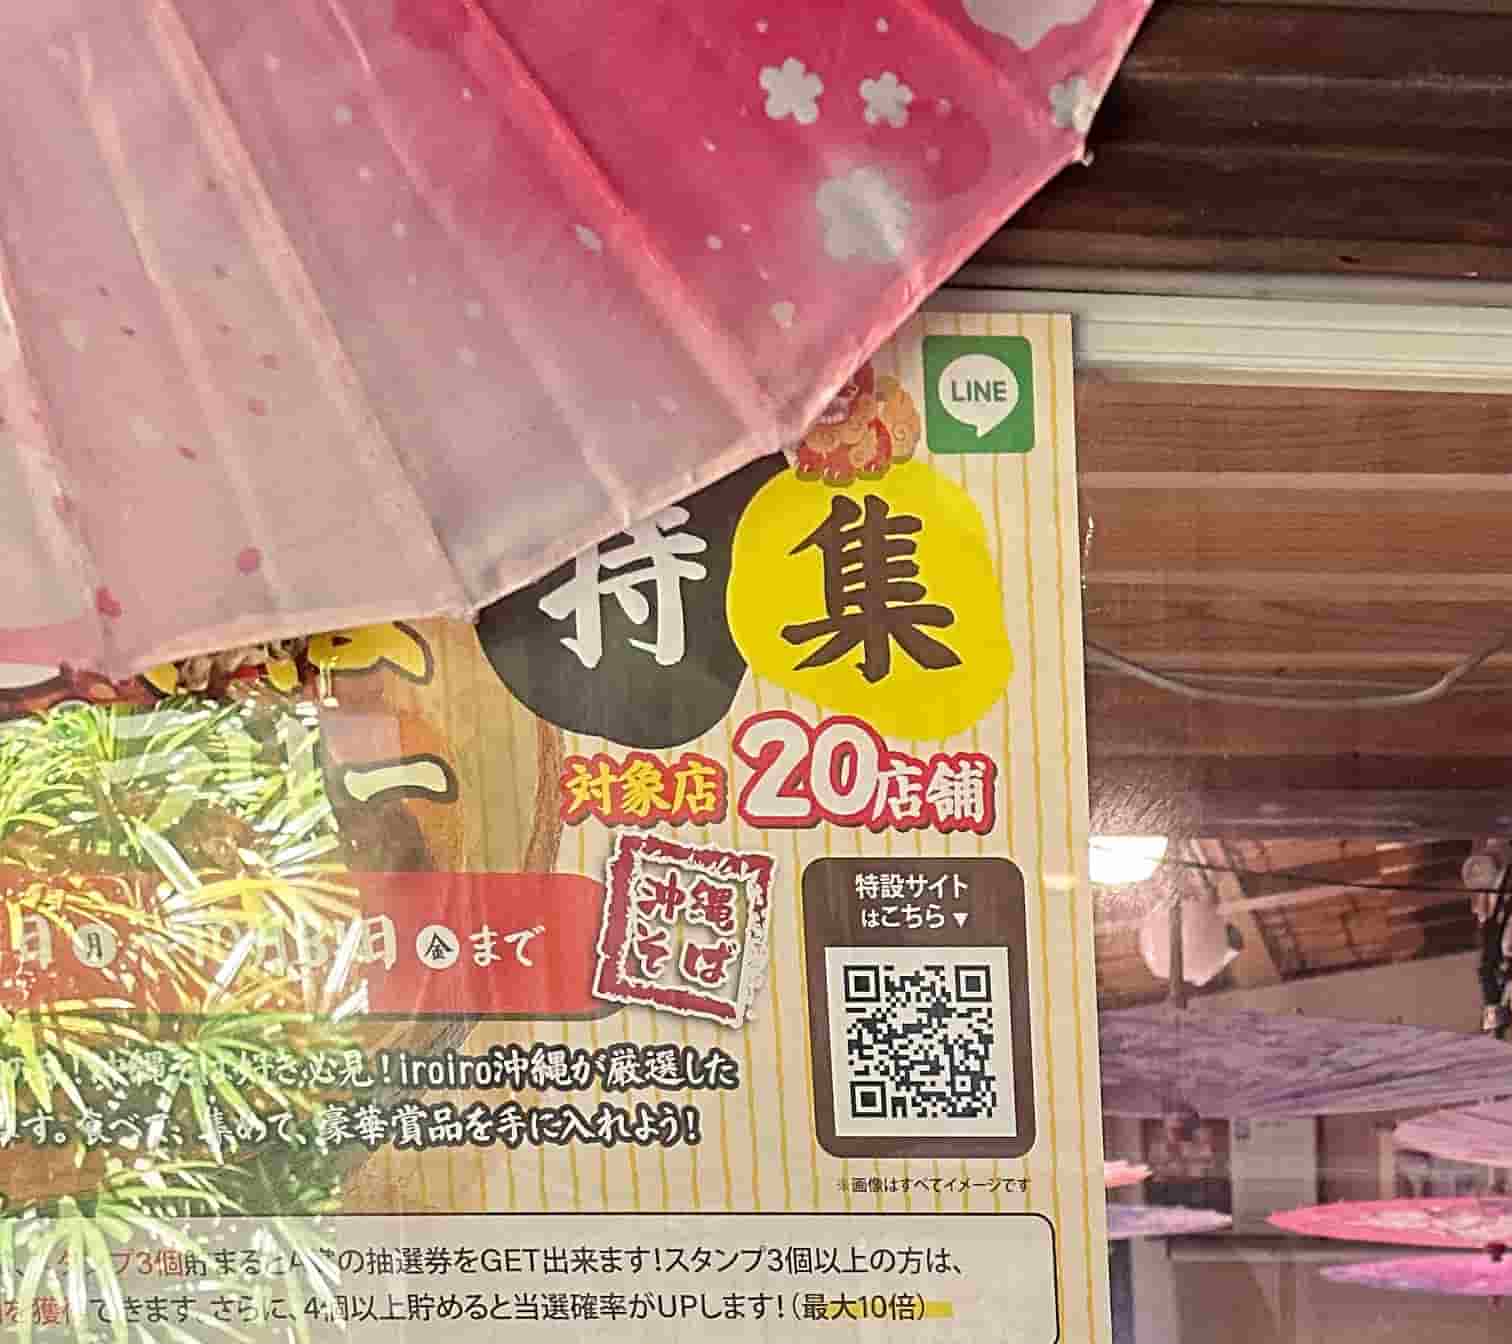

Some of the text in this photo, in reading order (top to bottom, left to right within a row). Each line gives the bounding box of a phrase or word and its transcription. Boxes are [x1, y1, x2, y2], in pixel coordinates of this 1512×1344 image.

[951, 380, 1008, 403] LINE
[561, 709, 998, 832] 対象店20店舗
[854, 872, 969, 899] 特設サイト
[861, 904, 946, 930] はこちら
